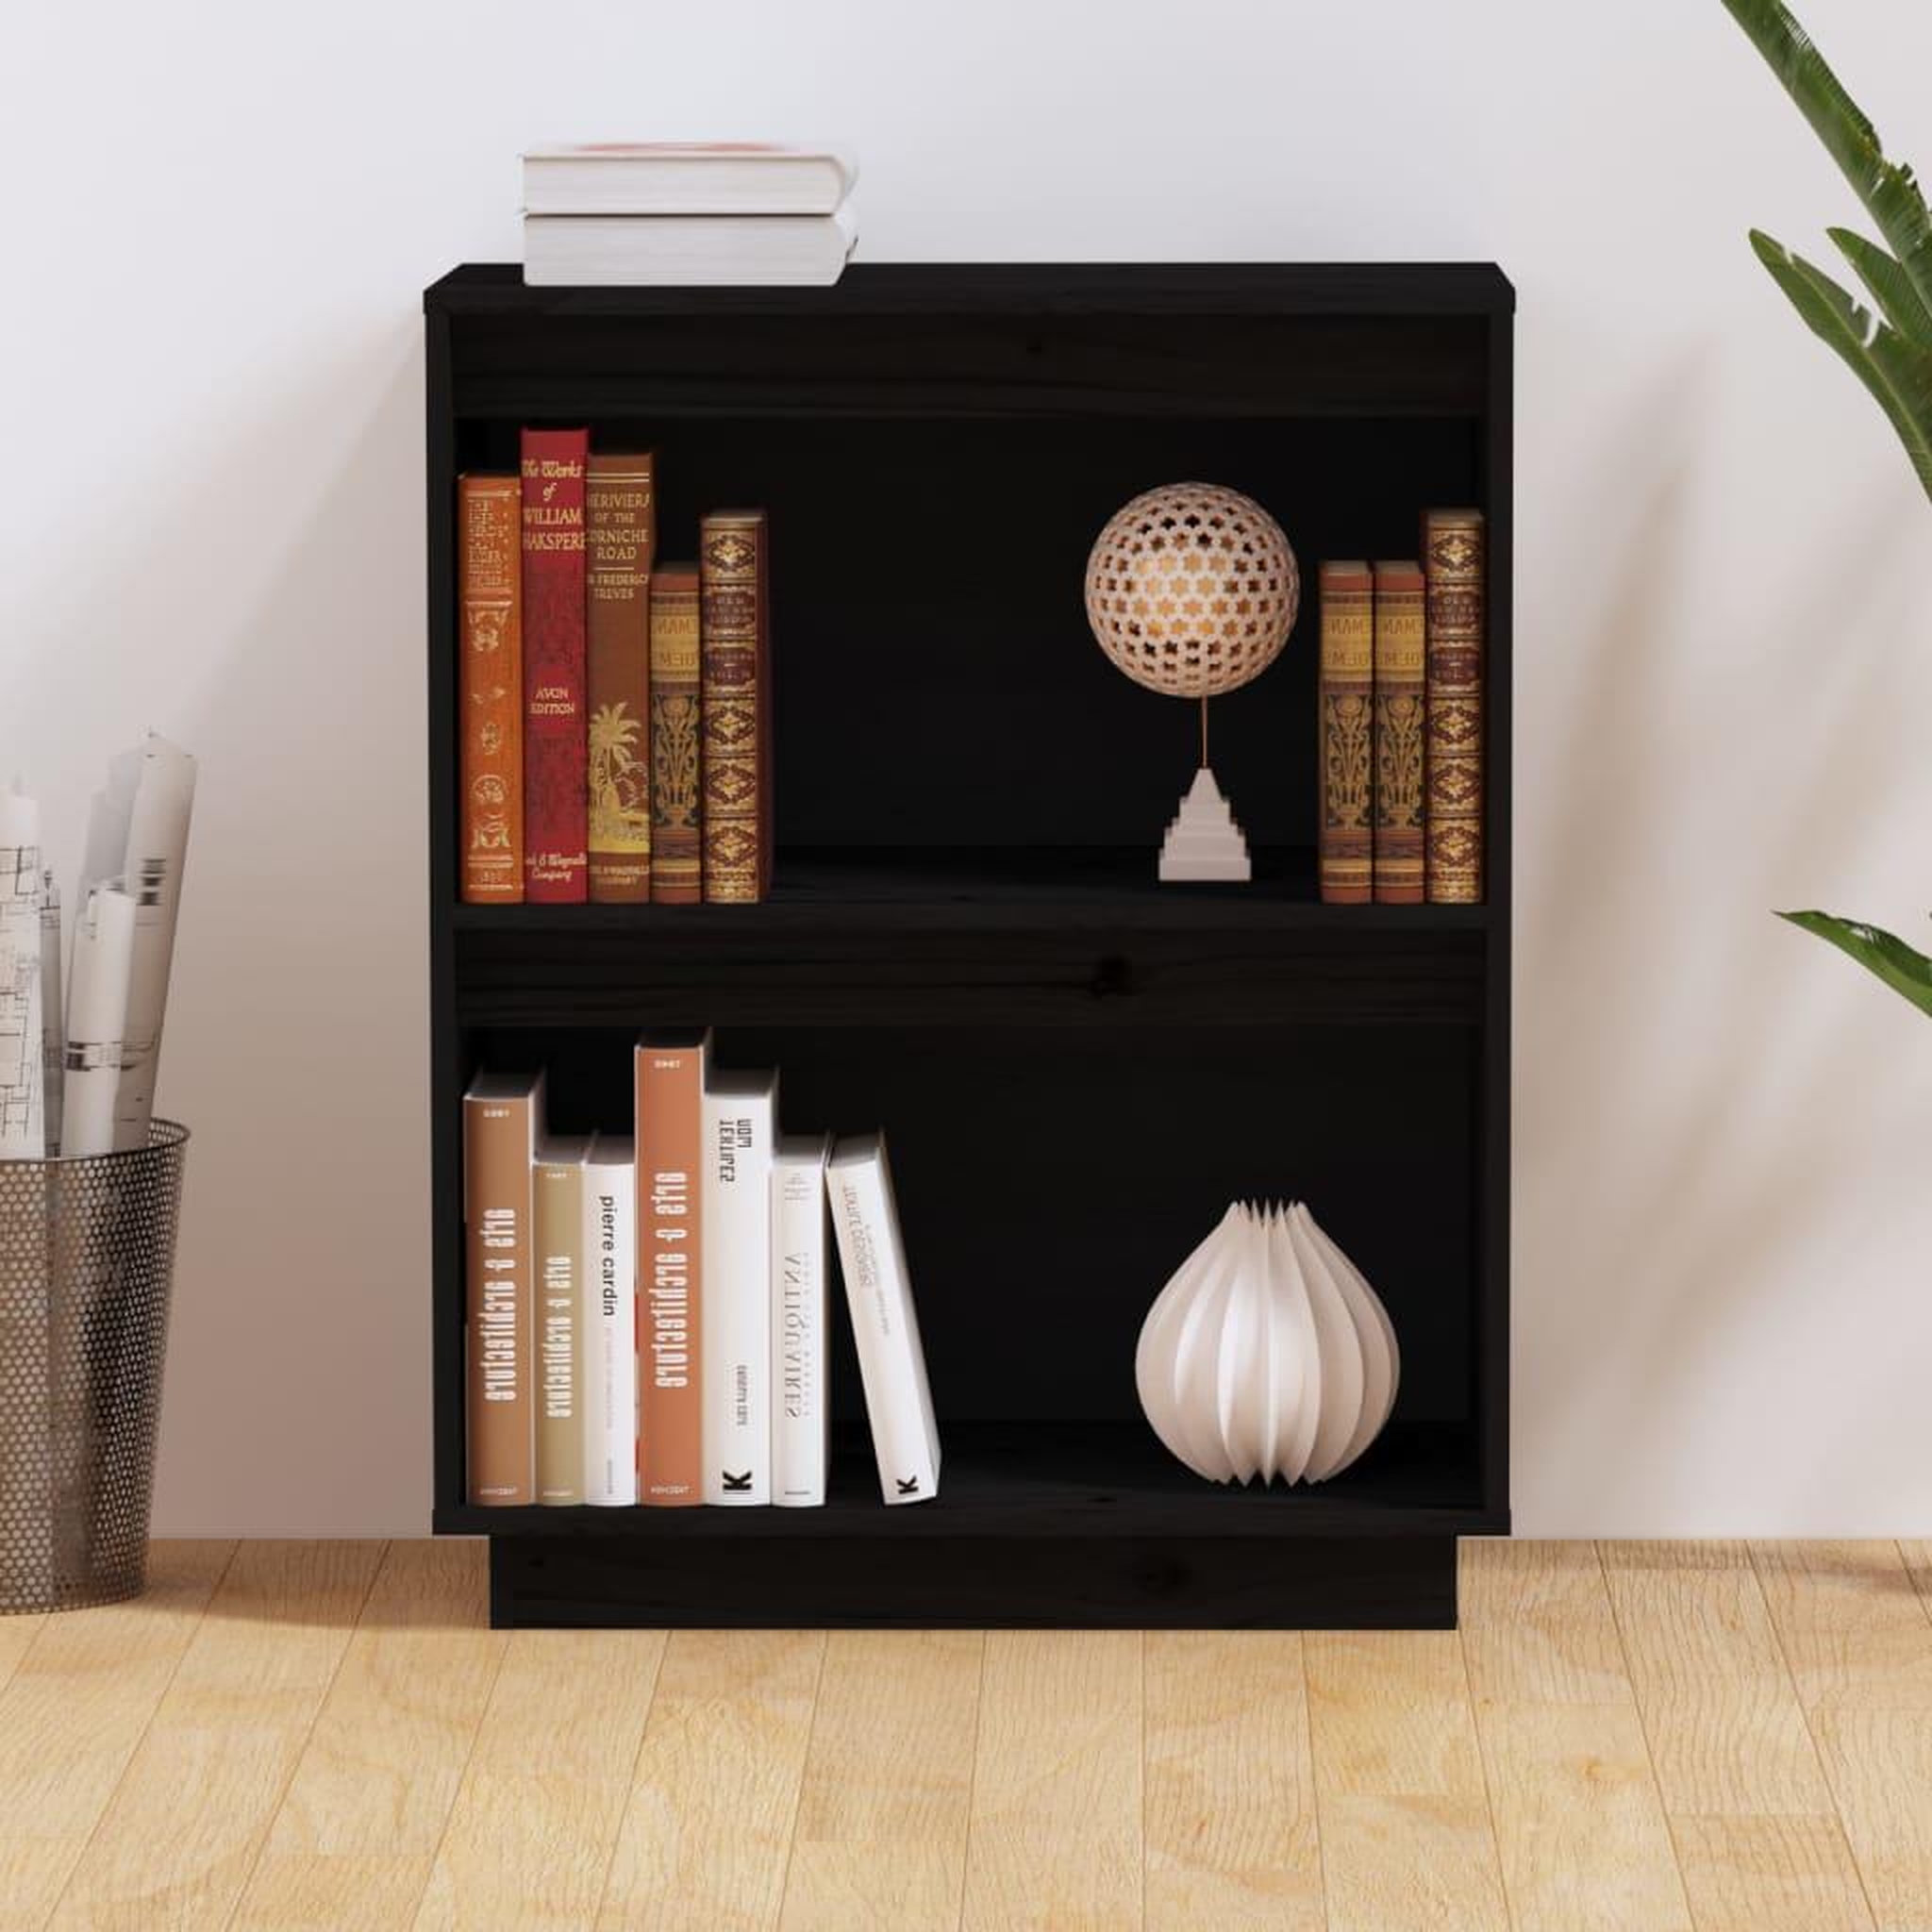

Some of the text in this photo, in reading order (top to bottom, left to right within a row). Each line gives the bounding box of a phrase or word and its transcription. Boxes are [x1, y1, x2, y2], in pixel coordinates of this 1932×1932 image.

[543, 482, 558, 502] of
[594, 512, 635, 524] OF THE
[596, 546, 637, 560] ROAD
[535, 688, 569, 699] AVON
[530, 702, 575, 714] EDITION
[599, 1195, 618, 1251] pierre
[602, 1257, 618, 1316] cardin
[722, 1470, 752, 1491] K
[896, 1475, 919, 1495] K
